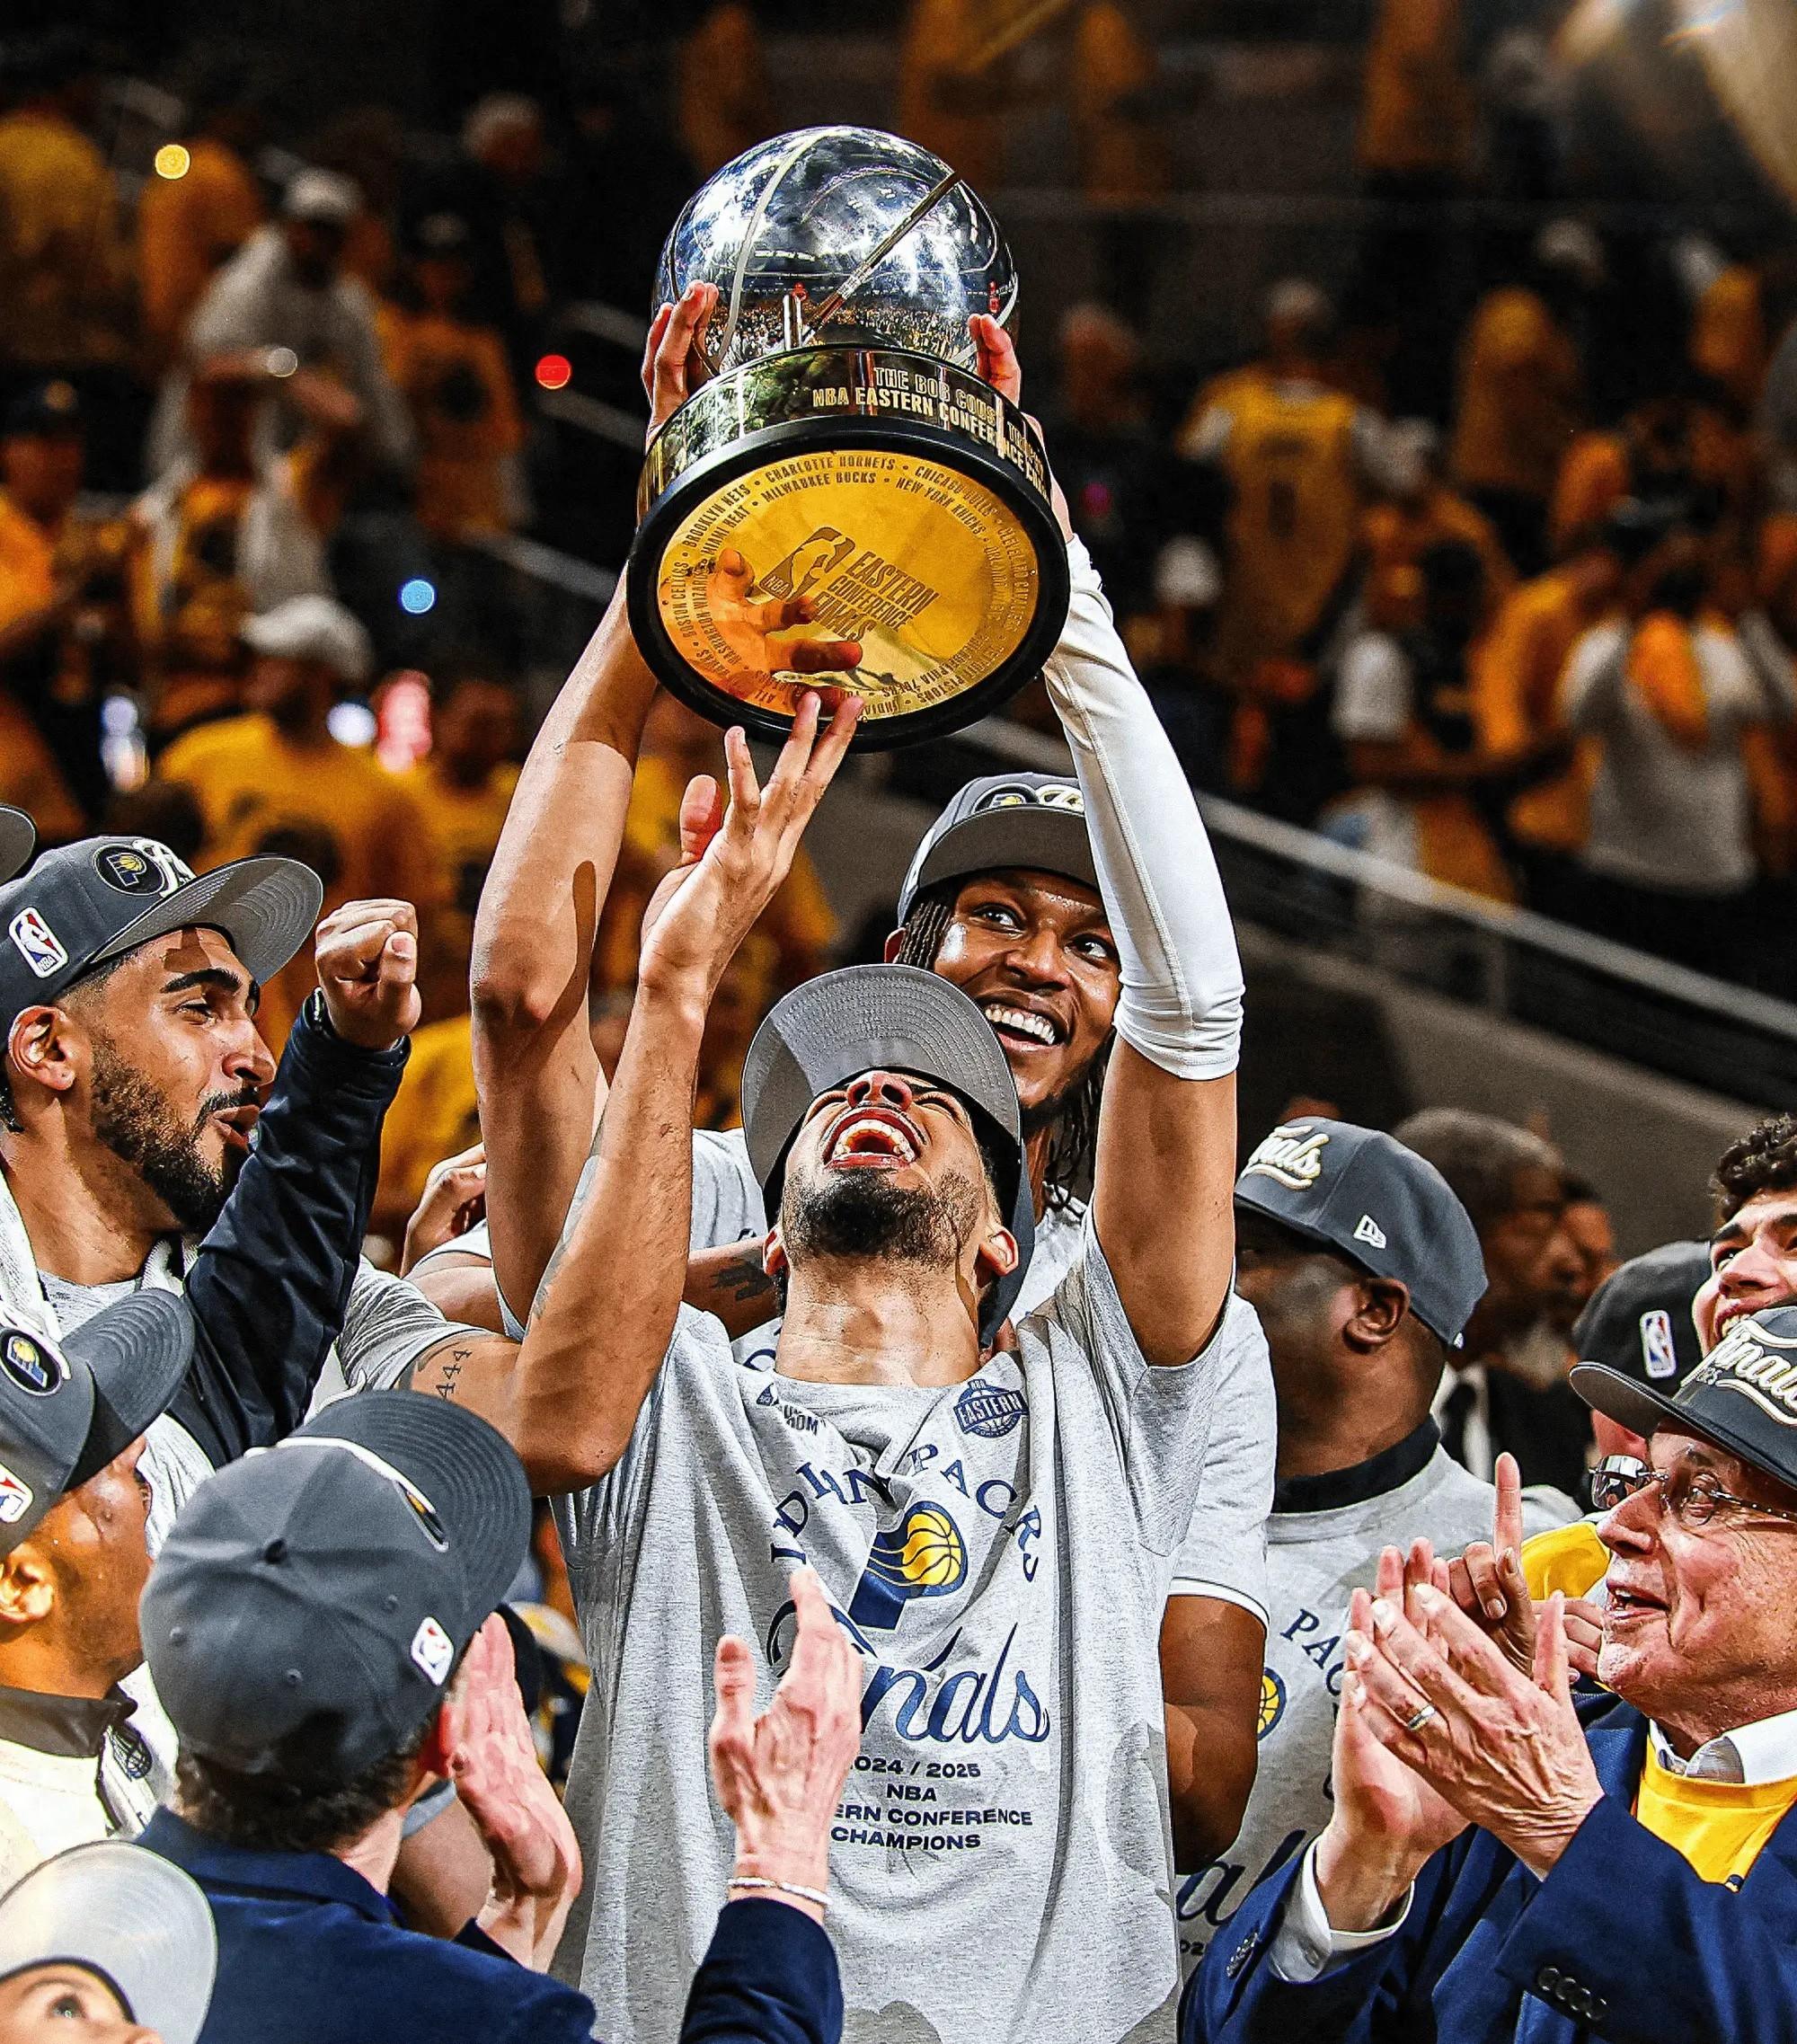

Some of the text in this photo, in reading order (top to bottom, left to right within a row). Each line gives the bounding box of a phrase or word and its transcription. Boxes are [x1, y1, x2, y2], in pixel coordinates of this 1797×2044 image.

[873, 367, 909, 391] THE
[915, 374, 950, 403] BOB
[812, 387, 849, 407] NBA
[855, 386, 934, 417] EASTERN
[765, 456, 834, 483] CHARLOTTE
[839, 456, 897, 471] HORNETS
[915, 465, 964, 494] CHICAGO
[721, 483, 751, 507] NETS
[684, 503, 726, 548] BROOKLYN
[701, 526, 730, 555] MIAMI
[722, 504, 751, 528] HEAT
[761, 473, 831, 502] MILWAUKEE
[836, 472, 877, 484] BUCKS
[896, 477, 924, 494] NEW
[924, 486, 954, 509] YORK
[951, 503, 987, 535] KNICKS
[764, 575, 791, 598] NBA
[845, 551, 940, 616] EASTERN
[812, 590, 878, 642] FINALS
[827, 575, 915, 632] CONFERENCE
[672, 603, 697, 638] BOSTON
[916, 674, 965, 703] PISTONS
[863, 699, 899, 716] INDIA
[957, 1393, 1022, 1428] EASTERN
[849, 1756, 981, 1778] 024 / 2025
[886, 1783, 937, 1802] NBA
[887, 1808, 1032, 1827] CONFERENCE
[830, 1827, 981, 1850] CHAMPIONS
